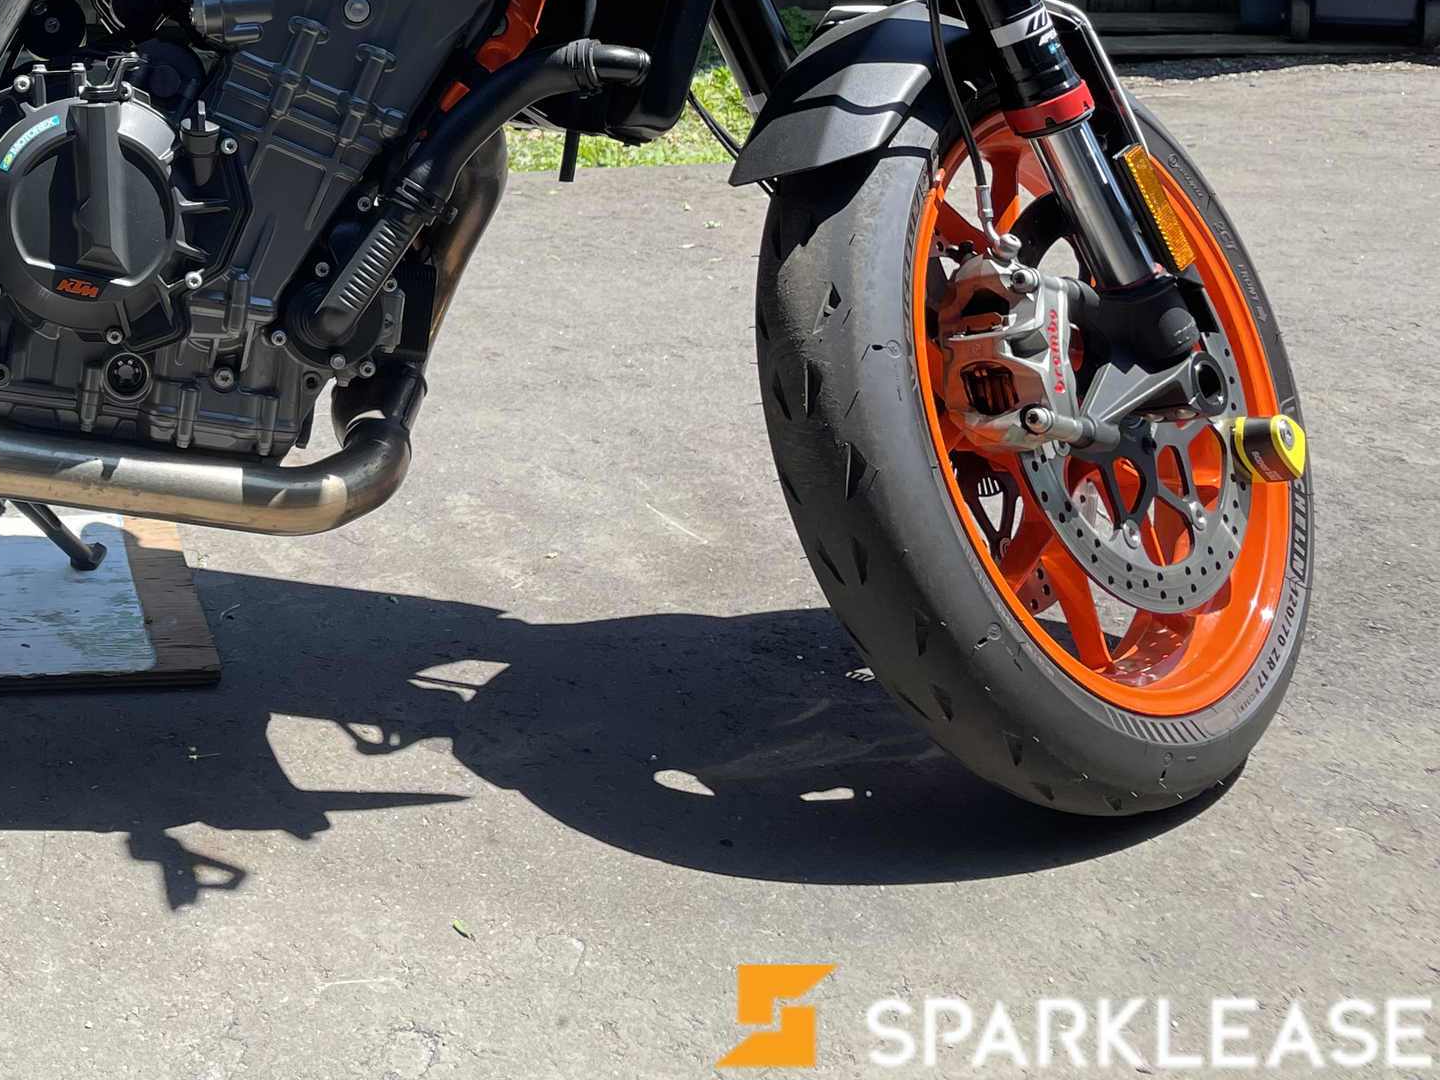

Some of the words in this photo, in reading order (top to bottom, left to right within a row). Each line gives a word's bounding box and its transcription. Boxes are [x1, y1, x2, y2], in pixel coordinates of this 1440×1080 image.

[55, 277, 101, 298] KTM
[1047, 308, 1066, 394] brembo
[1277, 584, 1300, 648] 120/70
[1265, 649, 1281, 666] ZR
[1257, 670, 1270, 689] 17
